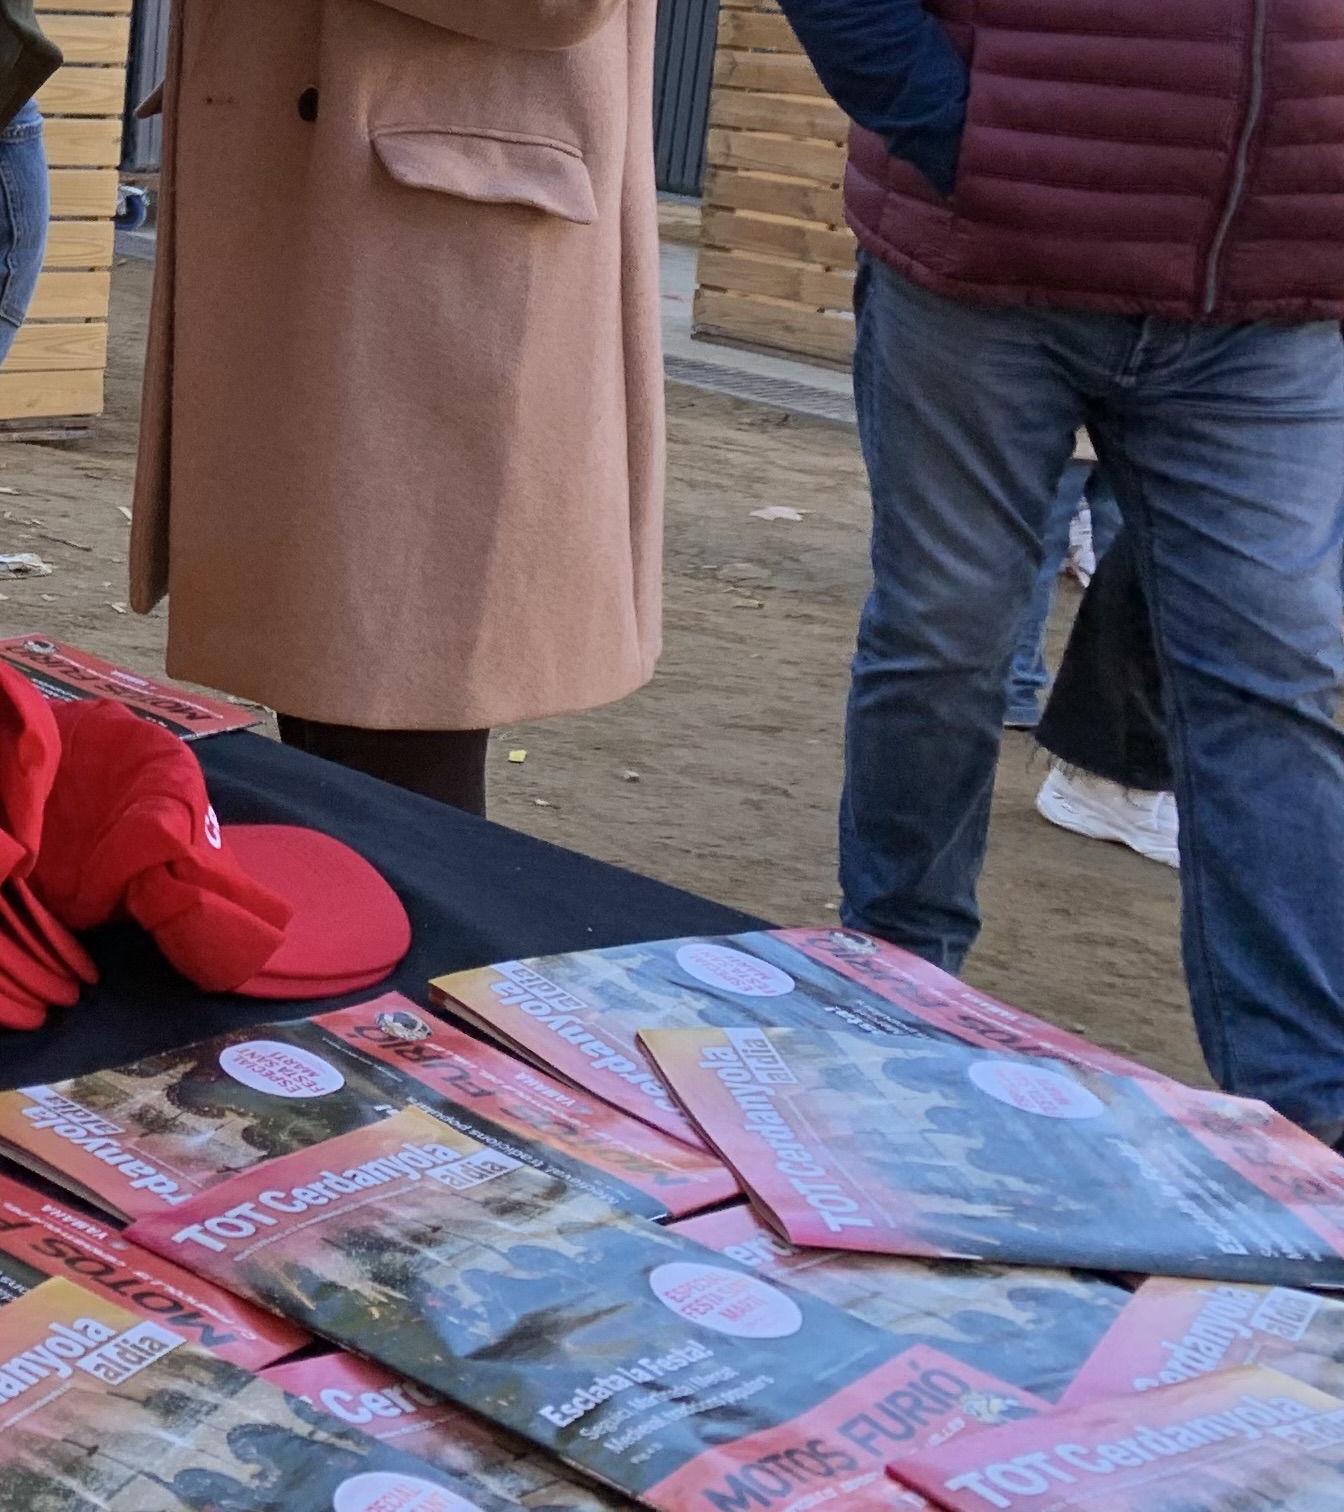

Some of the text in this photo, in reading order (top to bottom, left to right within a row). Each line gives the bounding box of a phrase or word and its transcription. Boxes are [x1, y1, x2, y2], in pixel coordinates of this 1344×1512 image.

[232, 1053, 302, 1094] ESPECIAL
[278, 1065, 326, 1094] FESTA
[698, 1047, 828, 1177] Cerdanyola
[22, 1106, 192, 1206] rdanyola
[171, 1203, 279, 1252] TOT
[258, 1141, 461, 1214] Cerdanyola
[788, 1178, 875, 1232] TOT
[40, 1203, 109, 1240] YAMAHA
[30, 1237, 238, 1347] MOTOS
[538, 1372, 636, 1428] Esclata
[637, 1338, 715, 1378] Festa!
[700, 1439, 860, 1512] MOTOS
[837, 1360, 972, 1458] FURIÓ
[945, 1451, 1078, 1509] TOT
[1055, 1394, 1313, 1475] Cerdanyola
